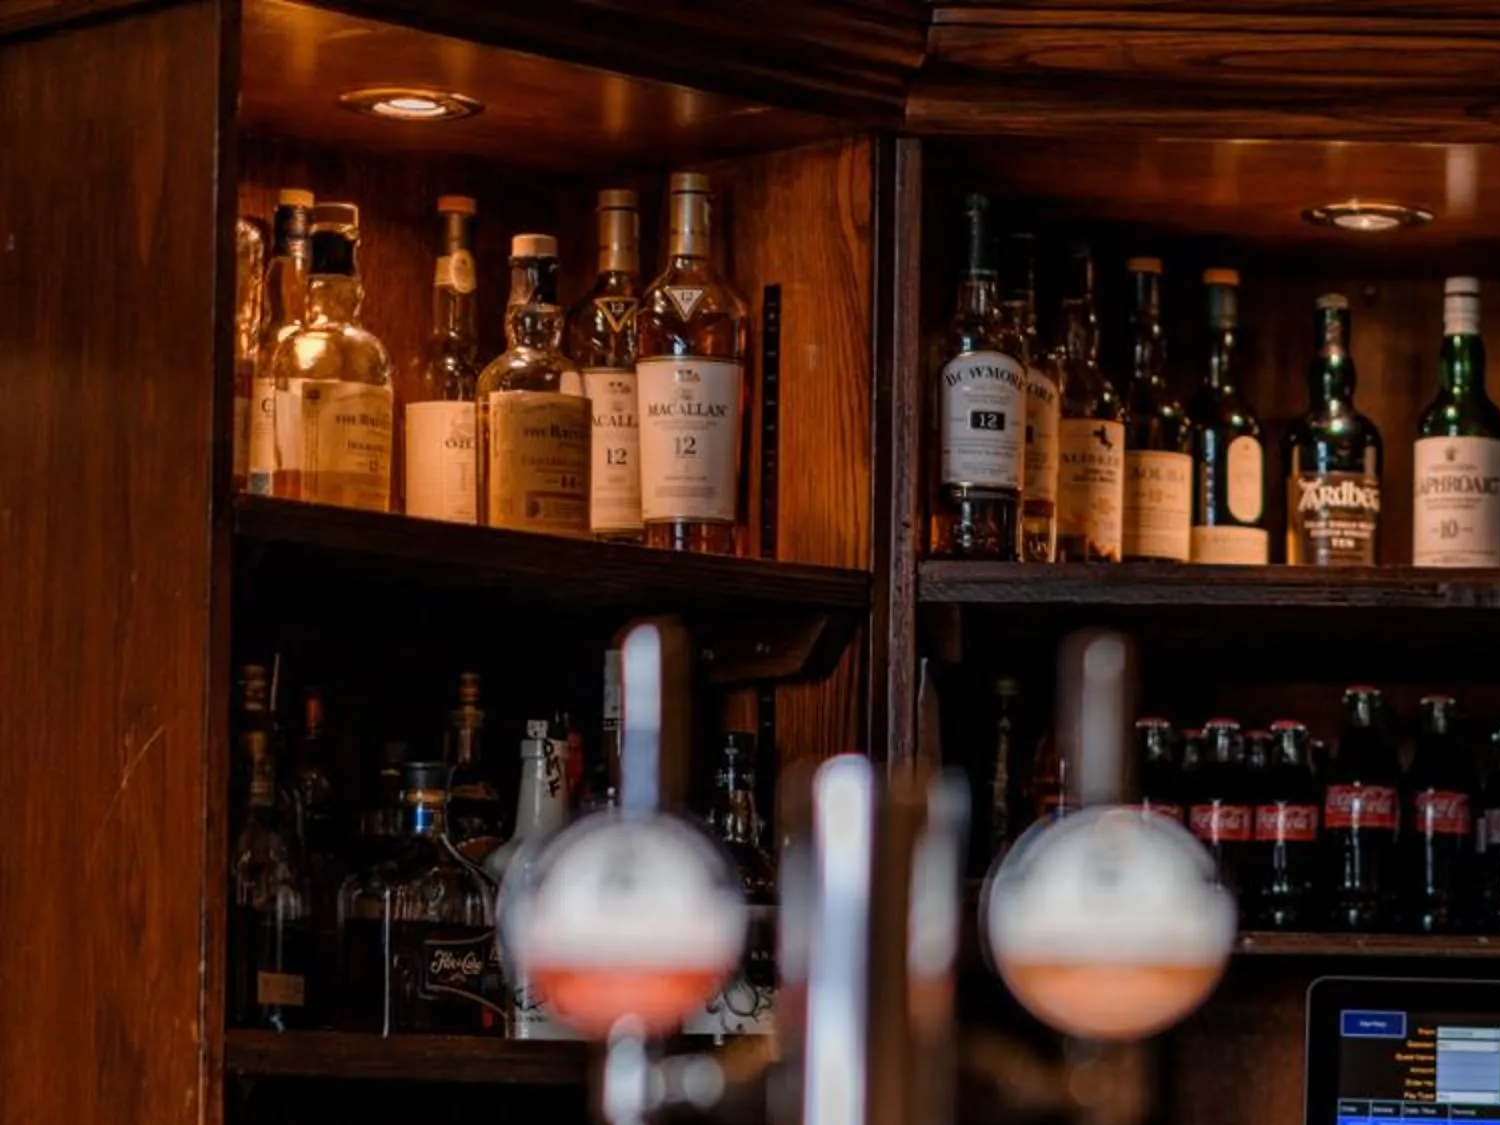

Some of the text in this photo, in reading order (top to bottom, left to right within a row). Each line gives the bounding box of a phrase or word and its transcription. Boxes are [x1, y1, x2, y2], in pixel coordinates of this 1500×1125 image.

[647, 403, 728, 418] MACALLAN
[979, 413, 998, 429] 12
[673, 436, 697, 456] 12
[606, 447, 627, 465] 12
